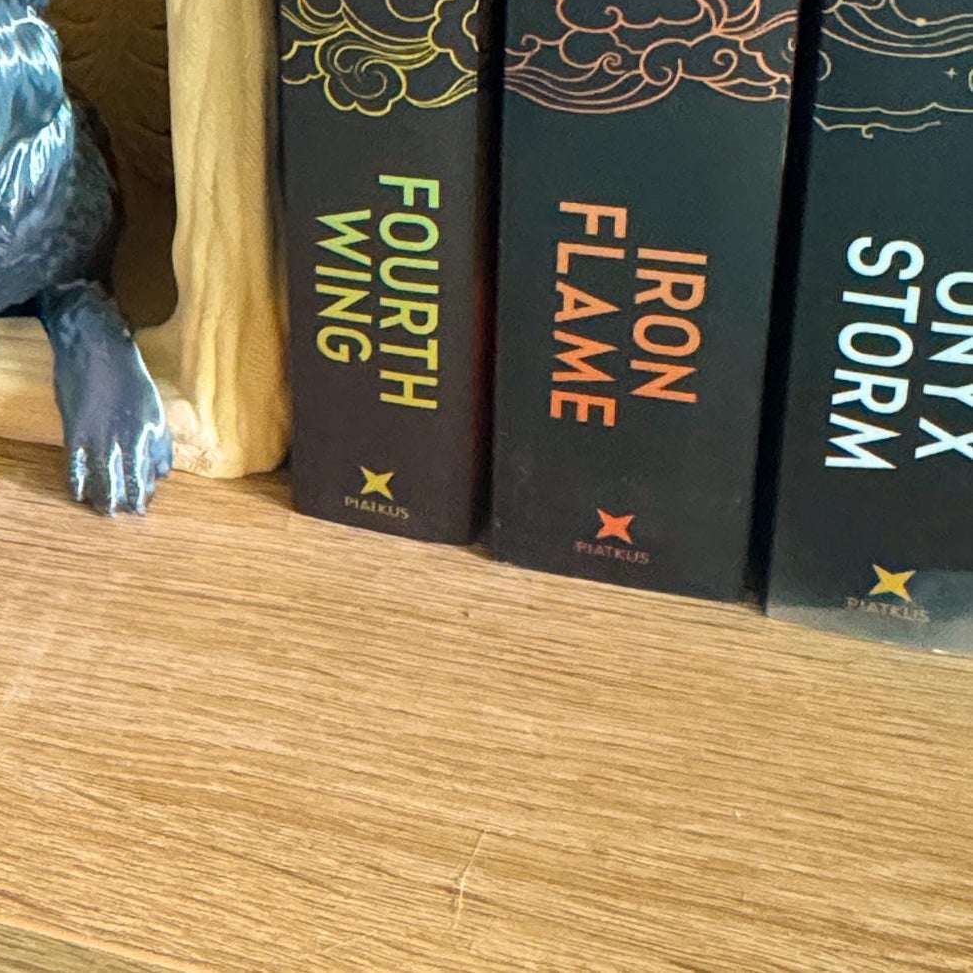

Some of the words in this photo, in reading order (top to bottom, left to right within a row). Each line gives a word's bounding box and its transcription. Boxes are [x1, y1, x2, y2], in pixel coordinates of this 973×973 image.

[314, 209, 372, 365] WING
[378, 173, 441, 410] FOURTH
[549, 201, 628, 427] FLAME
[628, 246, 708, 404] IRON
[824, 236, 925, 470] STORM
[344, 495, 410, 520] PIATKUS
[572, 540, 651, 565] PIATKUS
